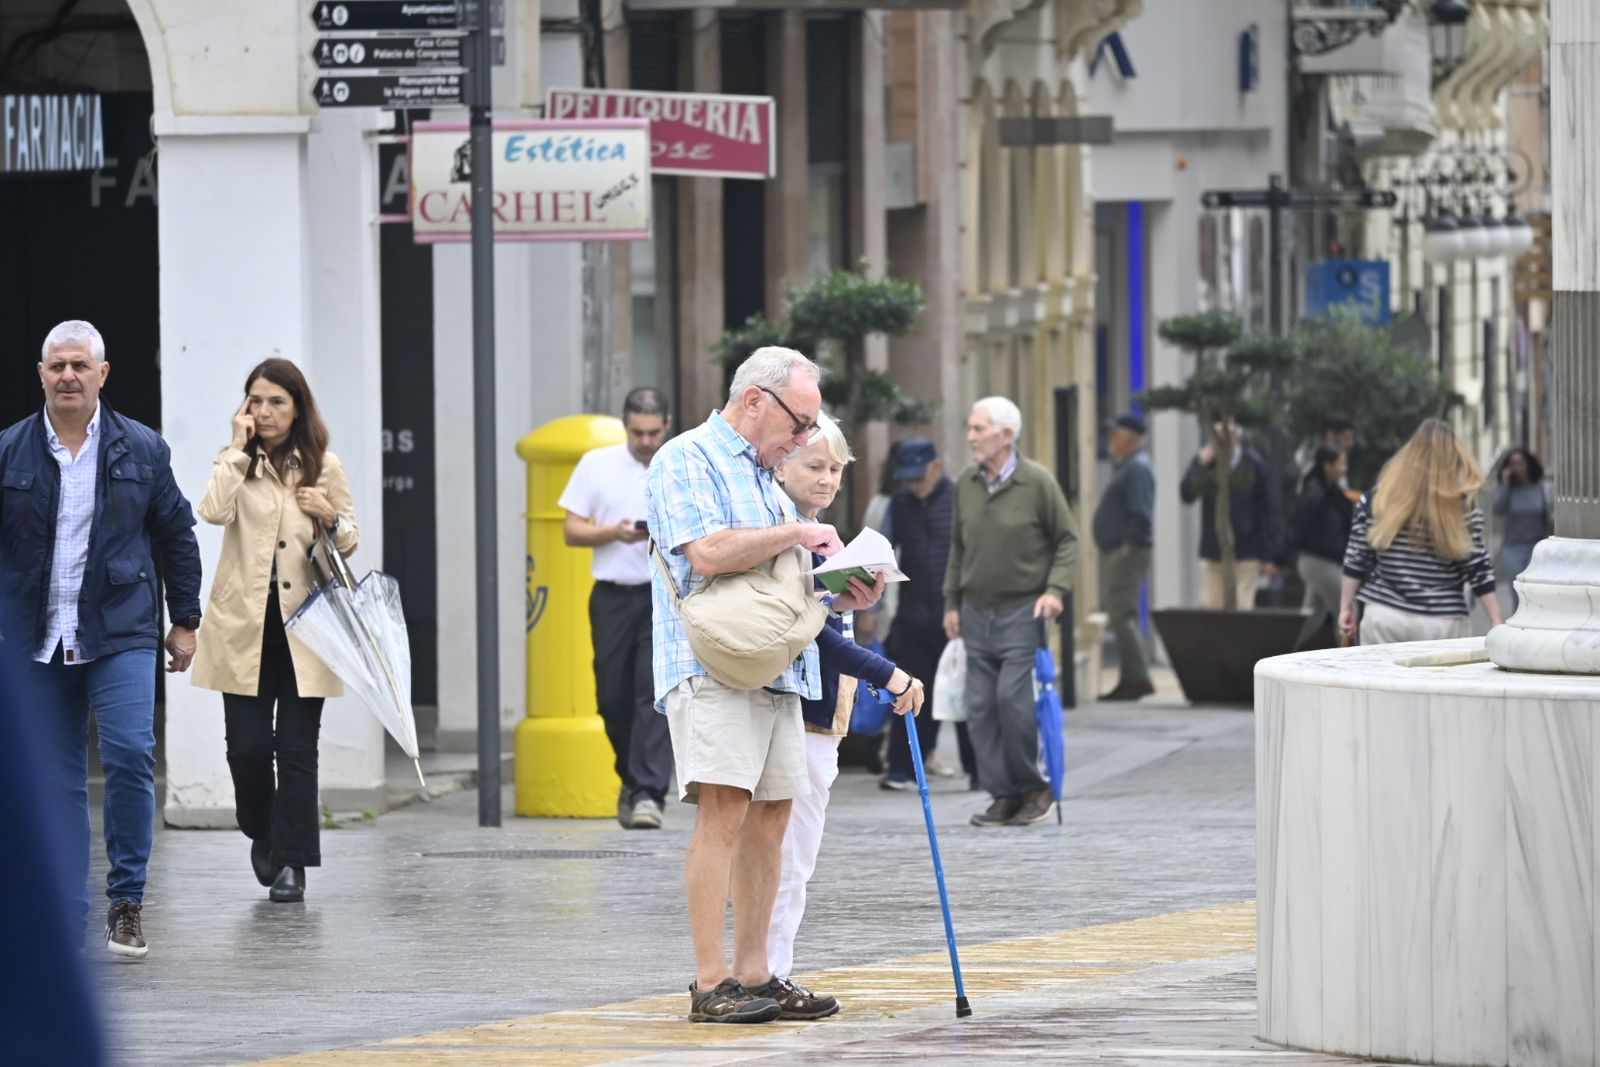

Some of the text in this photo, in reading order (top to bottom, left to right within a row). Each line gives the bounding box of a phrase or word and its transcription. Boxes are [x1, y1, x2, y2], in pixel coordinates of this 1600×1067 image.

[401, 4, 457, 16] Ayuntamient
[414, 39, 434, 48] Casa
[374, 49, 459, 60] Palacio de Congresos
[399, 76, 459, 85] Monumento de
[384, 87, 393, 97] la
[394, 87, 421, 98] Virgen
[423, 86, 436, 96] del
[554, 93, 762, 145] PELUQUERIA
[4, 93, 104, 171] FARMACIA
[503, 134, 626, 163] Estética
